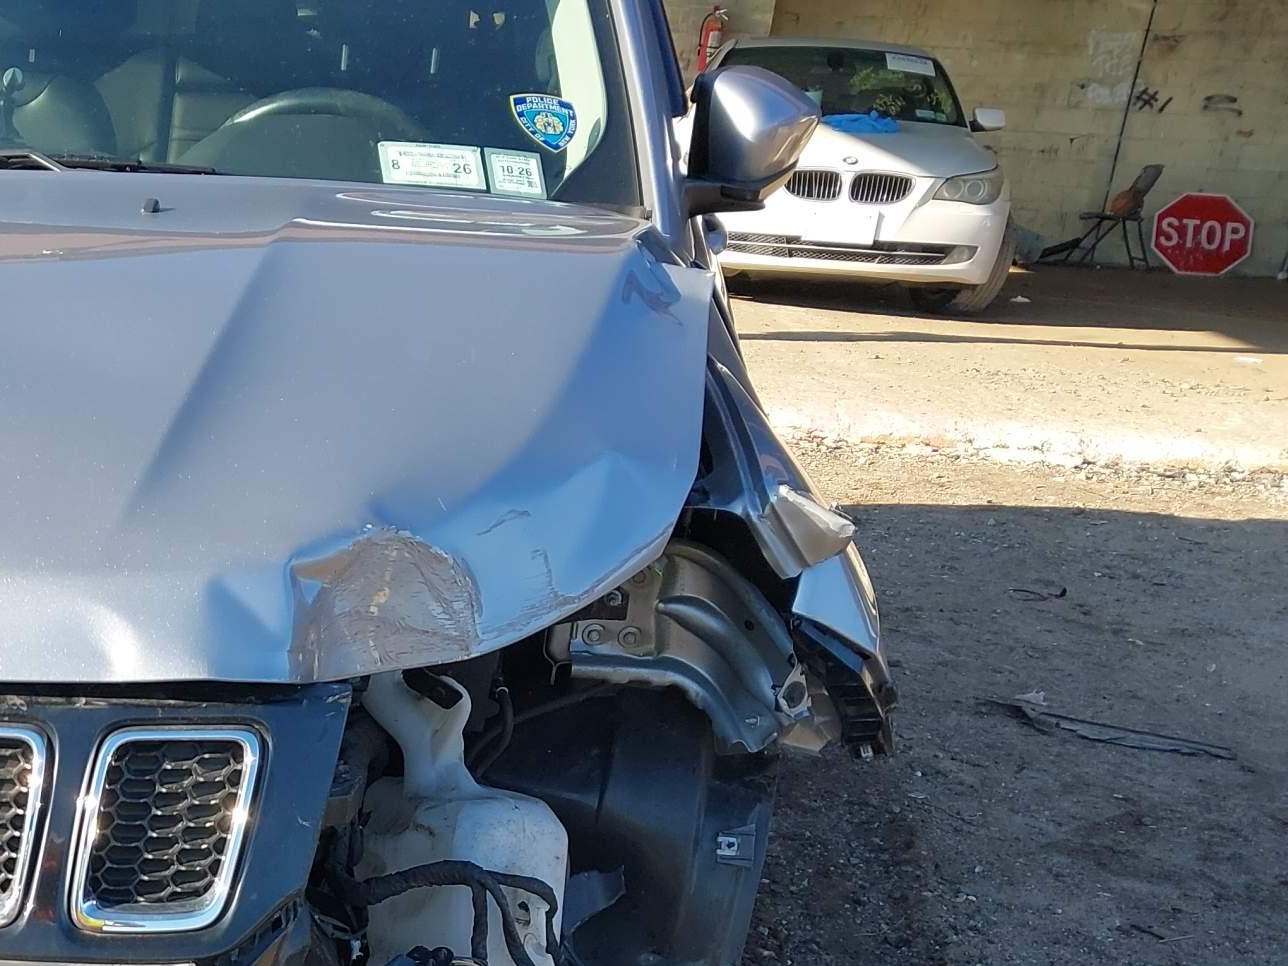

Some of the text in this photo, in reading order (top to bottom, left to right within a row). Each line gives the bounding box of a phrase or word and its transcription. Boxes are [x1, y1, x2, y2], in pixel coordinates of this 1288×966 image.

[526, 97, 559, 106] POLICE
[516, 103, 573, 116] DEPARTMENT
[520, 117, 535, 131] CITY
[391, 160, 400, 169] 8
[453, 163, 472, 174] 26
[1160, 217, 1245, 252] STOP
